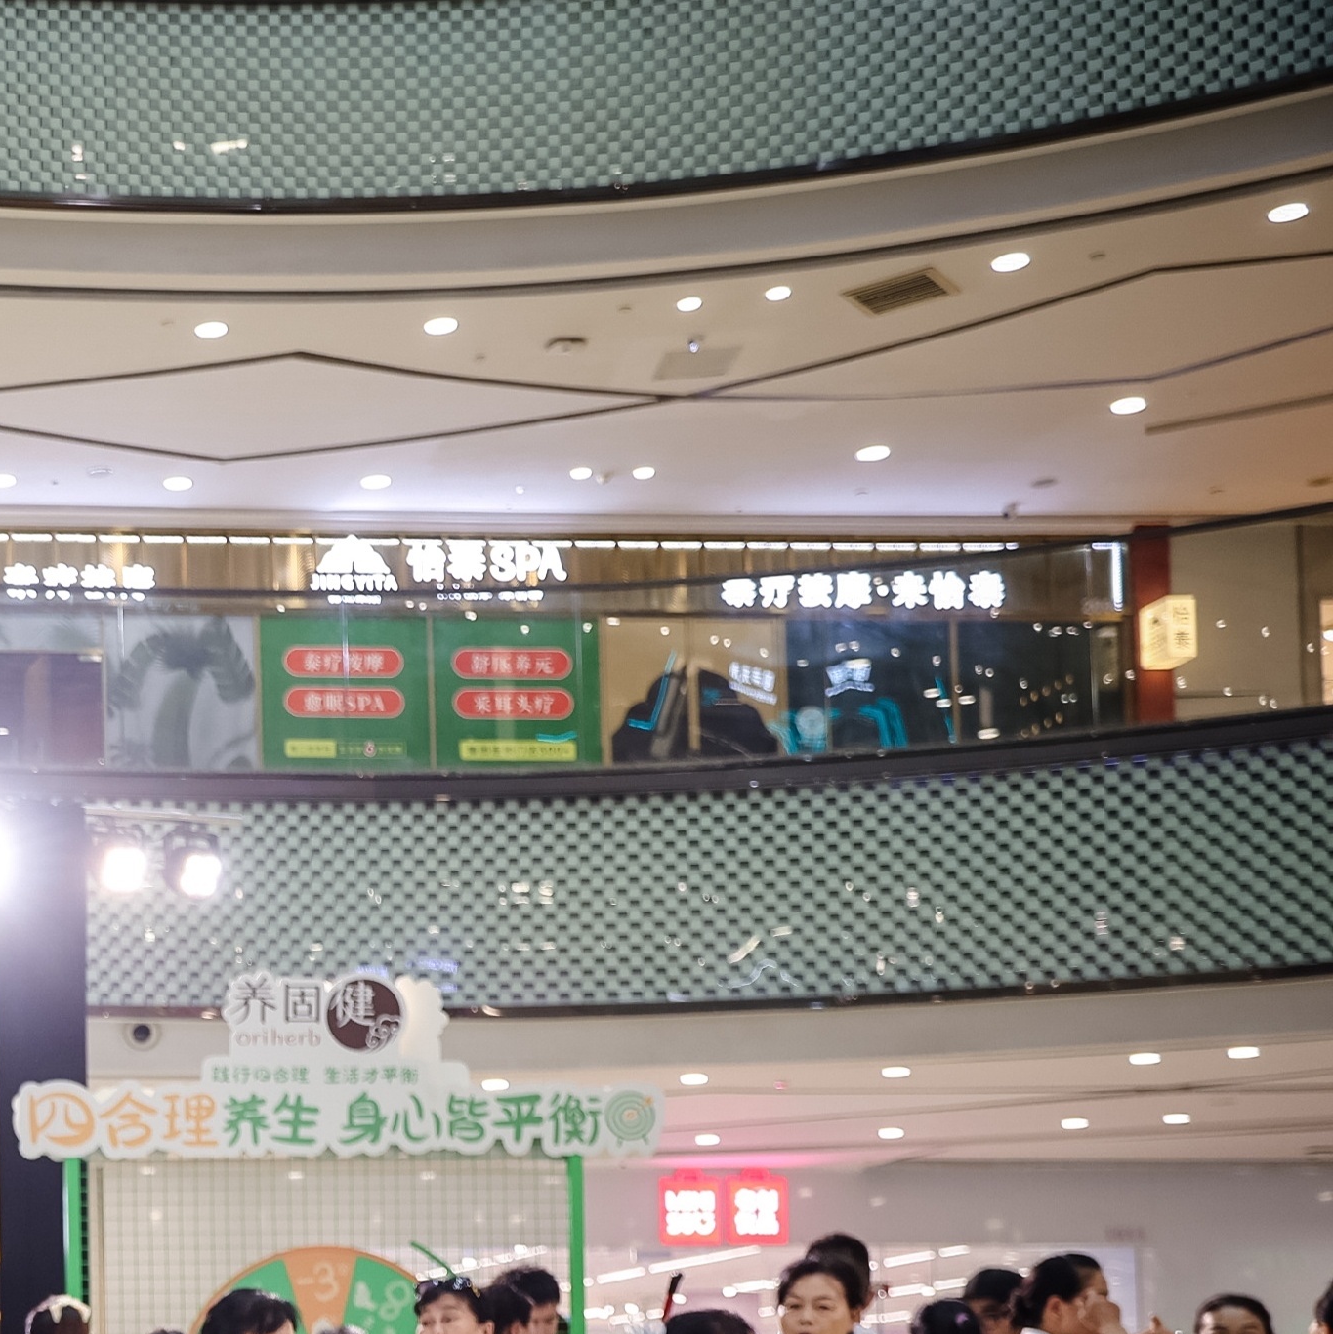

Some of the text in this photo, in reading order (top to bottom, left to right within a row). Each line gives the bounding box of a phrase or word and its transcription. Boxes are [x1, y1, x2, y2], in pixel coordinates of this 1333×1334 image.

[233, 974, 376, 1028] 养固健
[234, 1027, 322, 1048] oriherb
[29, 1092, 602, 1147] 四合理养生 身心皆平衡
